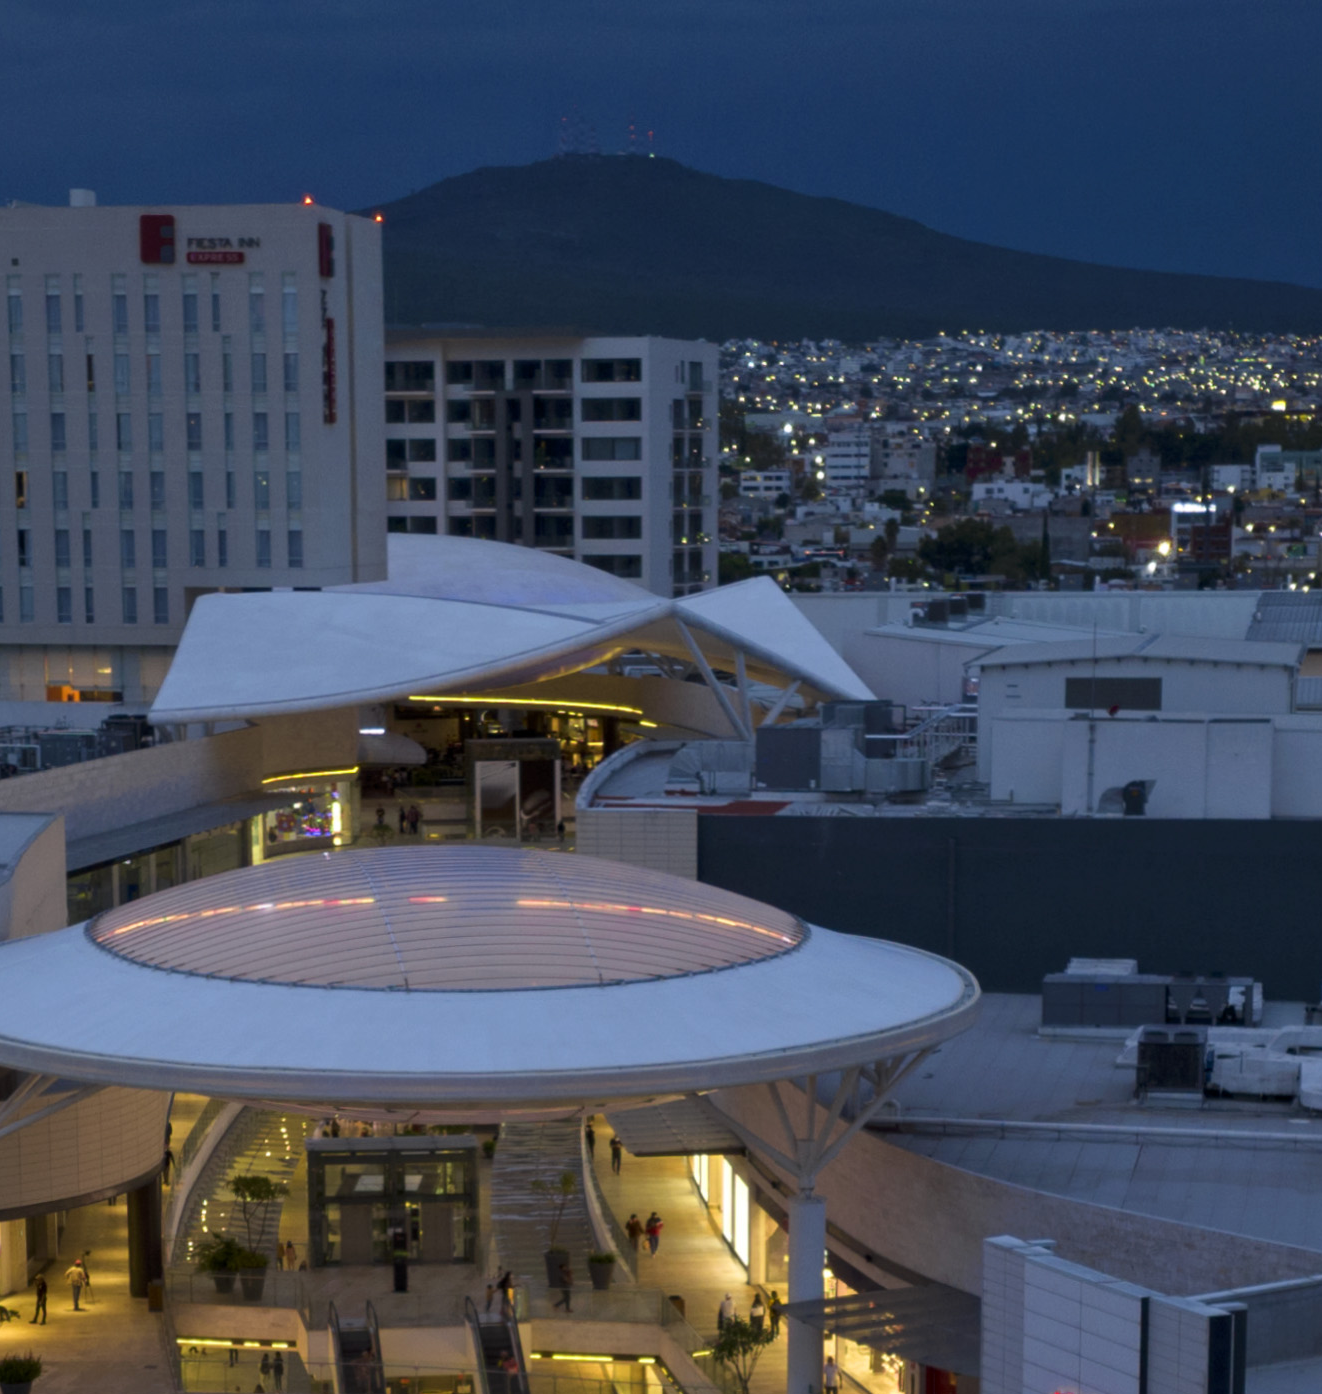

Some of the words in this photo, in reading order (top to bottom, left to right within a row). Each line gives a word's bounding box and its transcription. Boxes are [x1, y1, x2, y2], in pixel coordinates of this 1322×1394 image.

[187, 237, 232, 249] FIESTA
[238, 237, 261, 248] INN
[190, 253, 239, 263] EXPRESS
